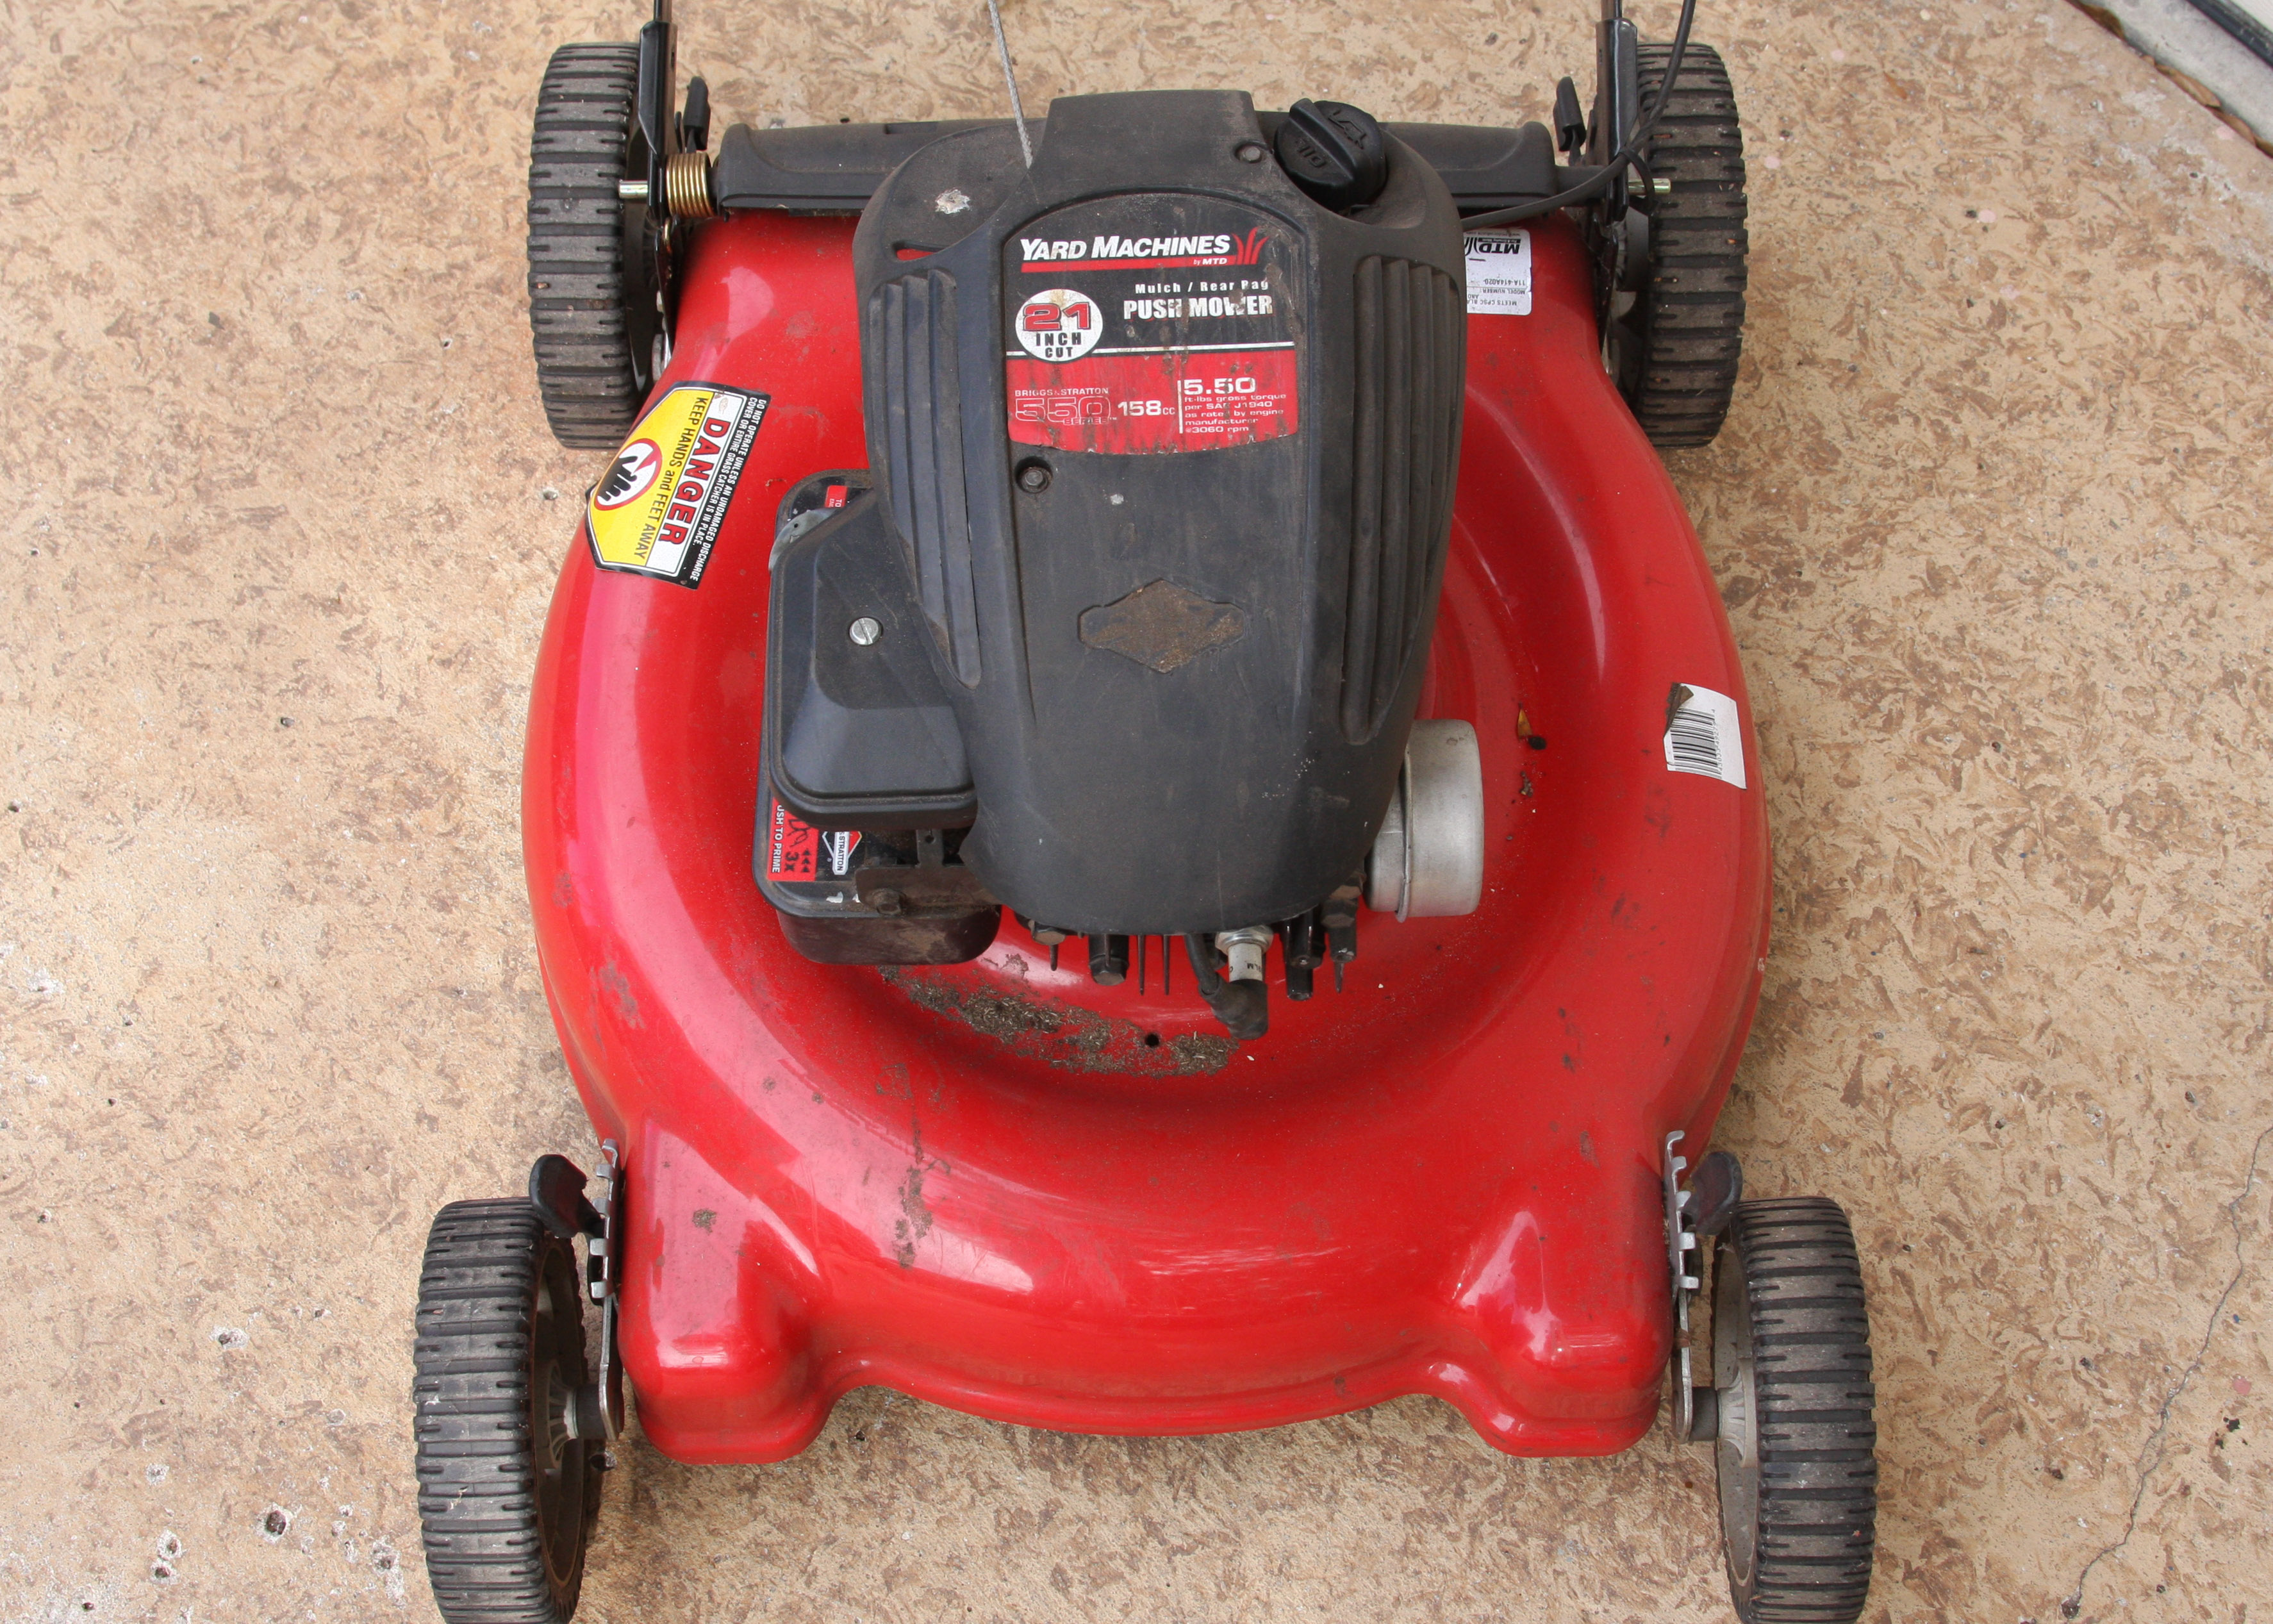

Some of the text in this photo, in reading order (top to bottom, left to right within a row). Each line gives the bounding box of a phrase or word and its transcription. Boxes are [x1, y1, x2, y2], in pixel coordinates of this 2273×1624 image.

[1020, 235, 1231, 261] YARD MACHINES
[1478, 243, 1520, 254] MTD
[1135, 282, 1181, 294] Mulch
[1200, 281, 1235, 292] Rear
[1023, 302, 1091, 331] 21
[1123, 295, 1273, 320] PUSH MOWER
[1036, 332, 1082, 346] INCH
[1045, 347, 1073, 358] CUT
[1184, 377, 1256, 395] 5.50
[1015, 395, 1111, 423] 550
[1234, 401, 1273, 409] J1940
[634, 397, 709, 559] KEEP HANDS and FEET AWAY
[658, 417, 731, 545] DANGER
[692, 397, 757, 545] COVER OR ENTIRE GRASS CATCHER IS IN PLACE.
[690, 399, 767, 581] DO NOT OPERATE UNLESS AN UNDAMAGED DISCHARGE
[772, 805, 785, 874] USH TO PRIME
[836, 836, 846, 871] STRATTON
